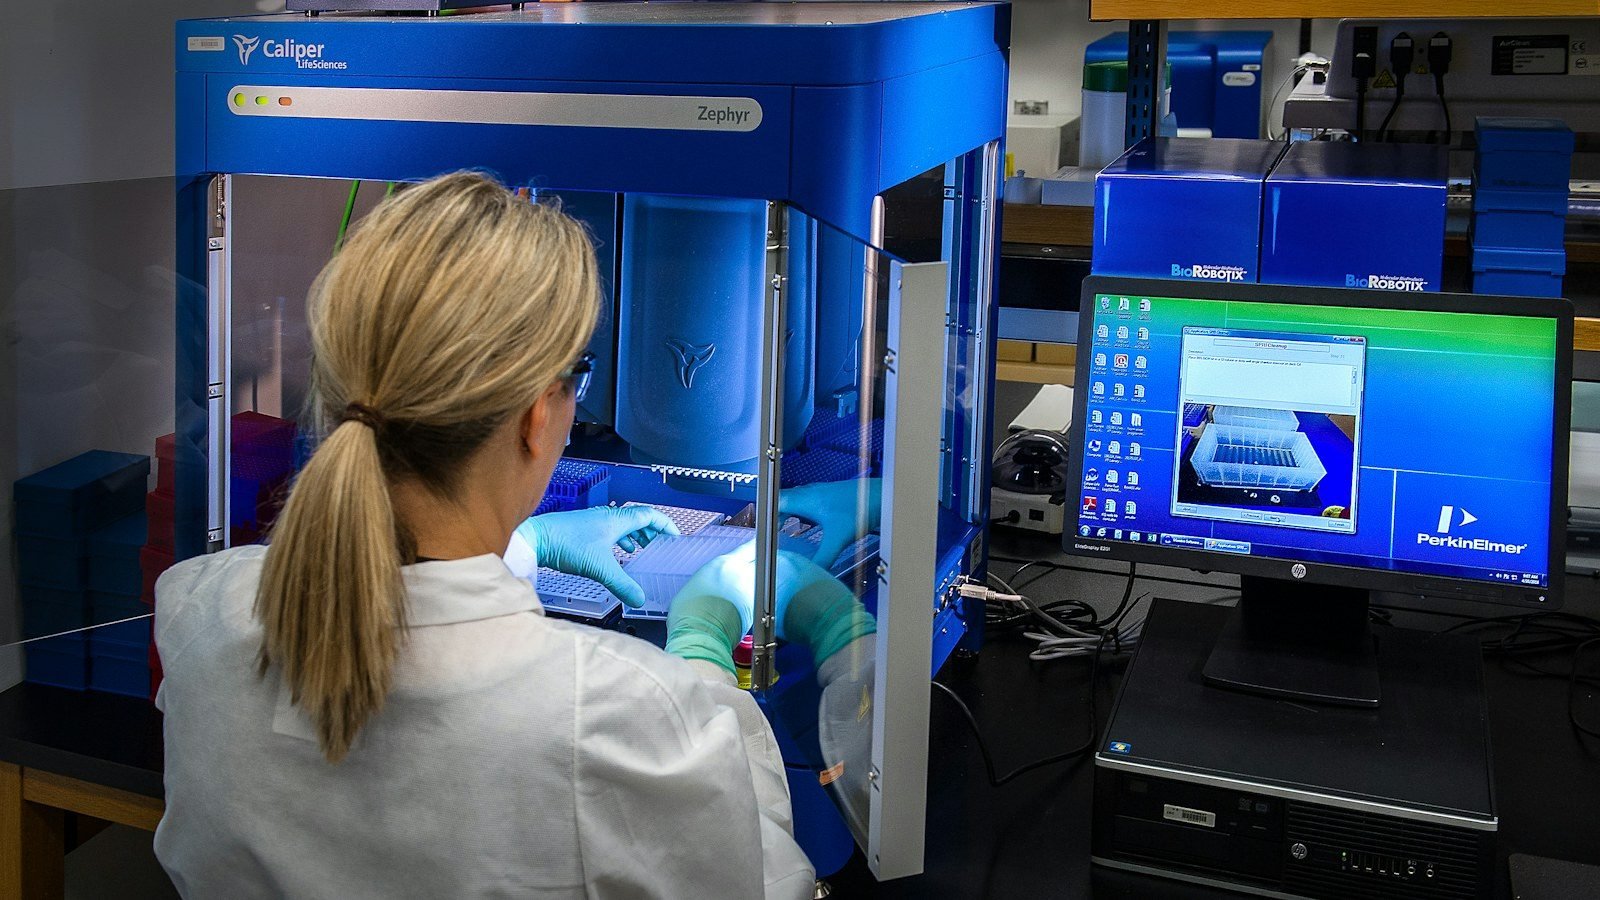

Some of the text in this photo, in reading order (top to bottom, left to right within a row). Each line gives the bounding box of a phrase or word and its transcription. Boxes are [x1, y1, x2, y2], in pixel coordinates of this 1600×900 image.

[263, 38, 325, 62] Caliper
[297, 59, 347, 69] LifeSciences
[697, 105, 750, 125] Zephyr
[1417, 532, 1528, 555] PerkinElmer
